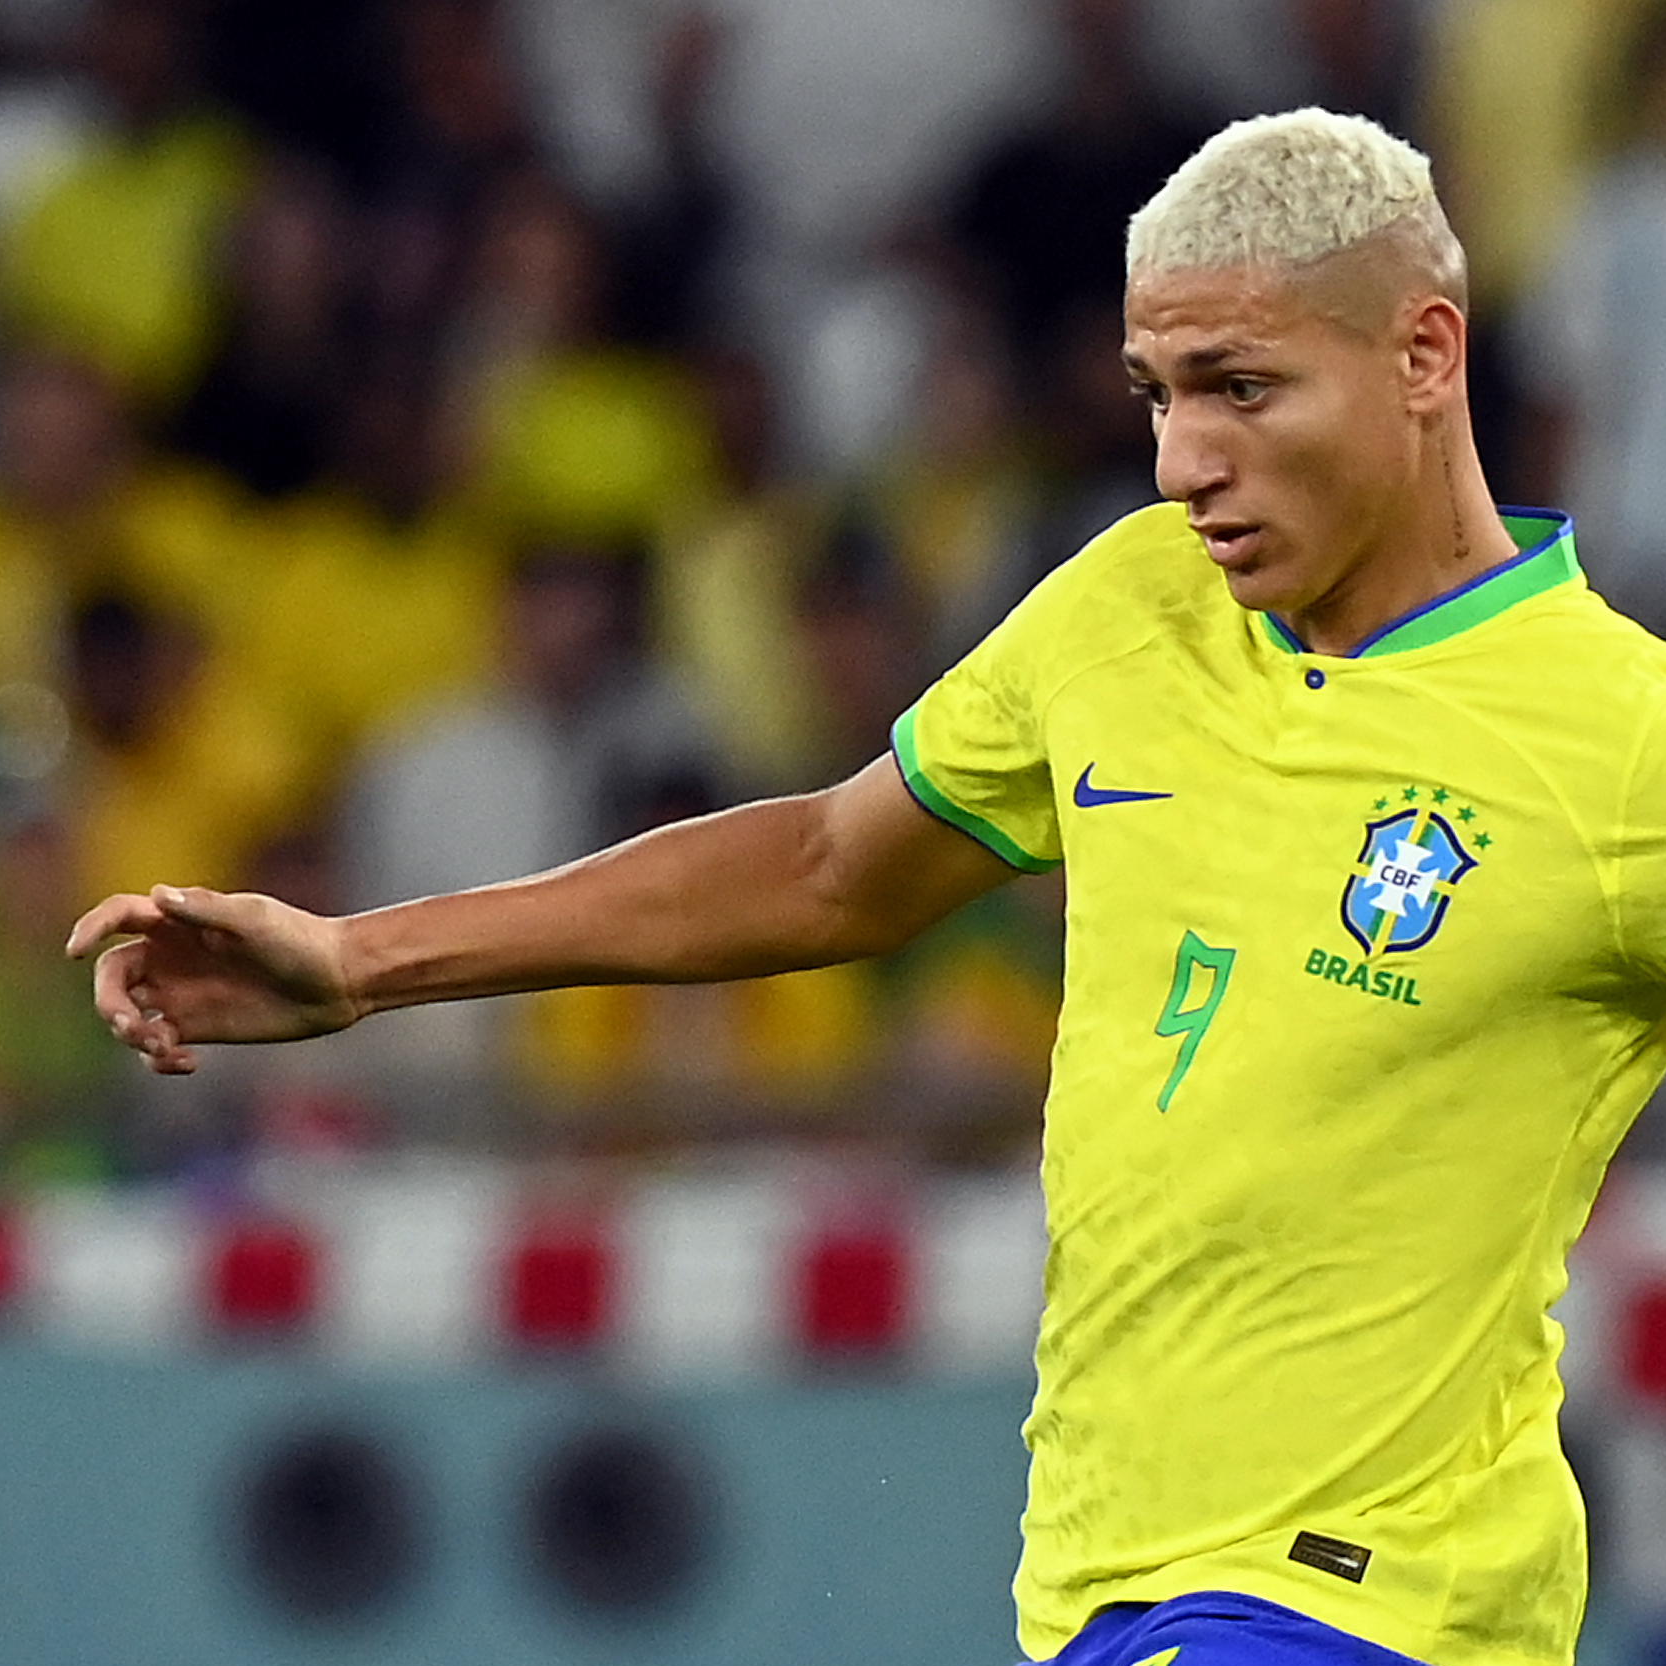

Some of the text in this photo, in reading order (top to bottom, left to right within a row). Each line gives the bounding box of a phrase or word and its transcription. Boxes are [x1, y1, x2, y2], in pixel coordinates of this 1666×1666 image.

[1380, 865, 1421, 889] CBF
[1304, 948, 1421, 1006] BRASIL
[1155, 929, 1236, 1114] 9
